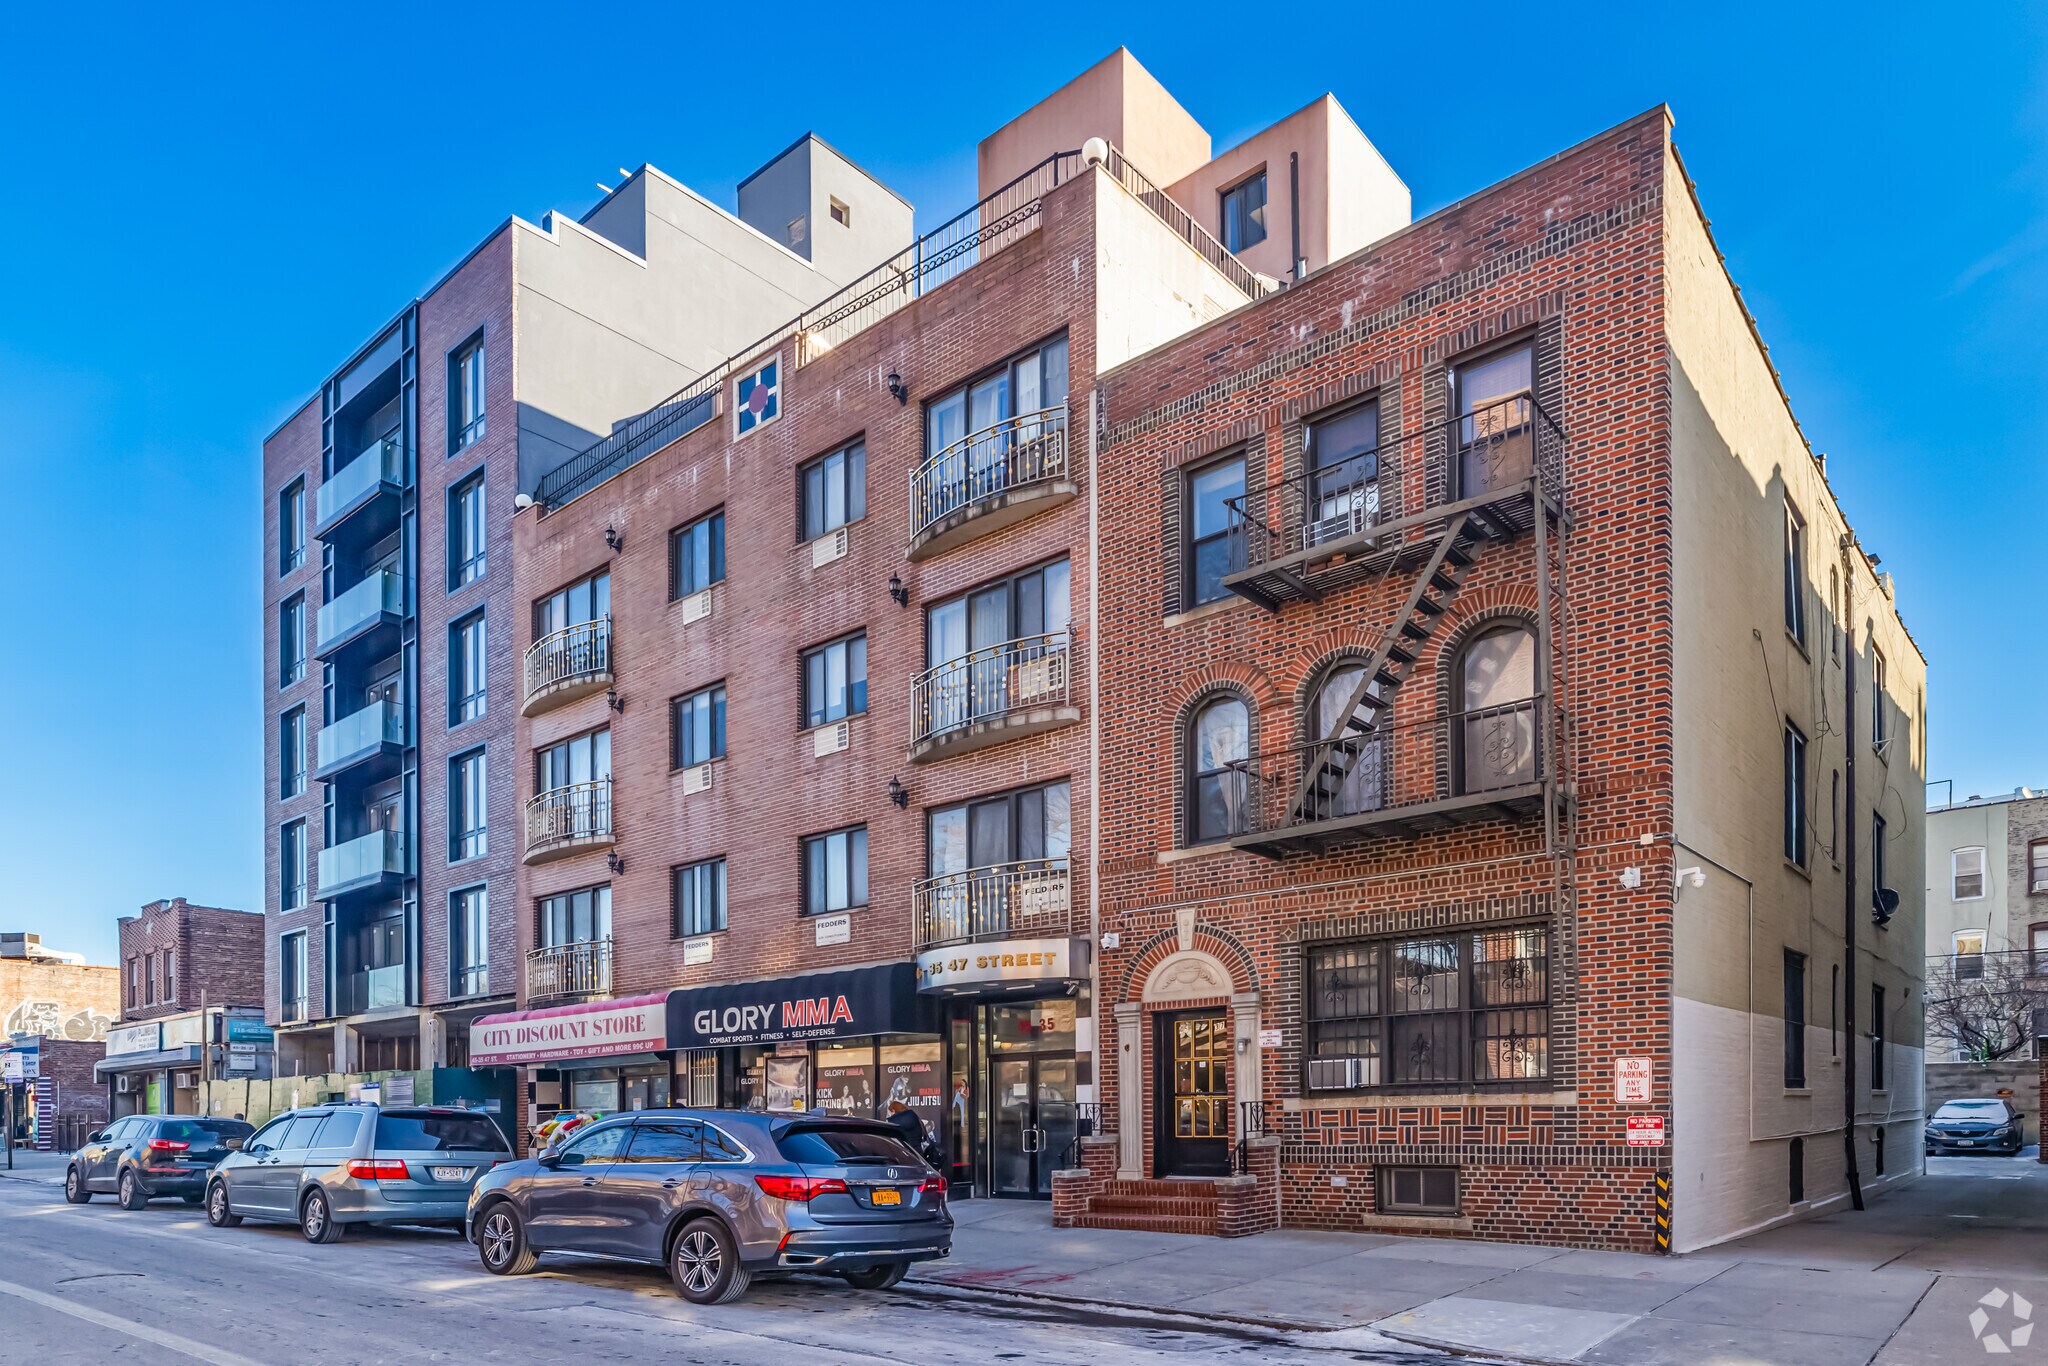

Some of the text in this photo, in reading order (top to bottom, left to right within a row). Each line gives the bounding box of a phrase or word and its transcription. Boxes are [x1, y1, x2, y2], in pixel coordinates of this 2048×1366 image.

[818, 919, 847, 929] FEDDERS
[686, 941, 709, 950] FEDDERS
[948, 958, 968, 971] 47
[976, 952, 1057, 969] STREET
[694, 995, 854, 1034] GLORY MMA
[483, 1014, 646, 1047] CITY DISCOUNT STORE
[1039, 1018, 1055, 1032] 35
[732, 1035, 754, 1043] SPORTS
[760, 1032, 784, 1040] FITNESS
[791, 1028, 836, 1038] SELF-DEFENSE
[506, 1052, 536, 1061] STATIONERY
[540, 1049, 569, 1058] HARDWARE
[588, 1046, 601, 1054] GIFT
[602, 1045, 614, 1053] AND
[614, 1043, 631, 1052] MORE
[645, 1041, 654, 1049] UP
[887, 1063, 931, 1074] GLORY MMA
[1627, 1062, 1640, 1070] NO
[824, 1068, 865, 1077] GLORY MMA
[1619, 1070, 1648, 1079] PARKING
[741, 1077, 760, 1085] GLORY
[816, 1088, 833, 1099] KICK
[816, 1098, 841, 1109] BOXING
[907, 1095, 941, 1107] JIU JITSU
